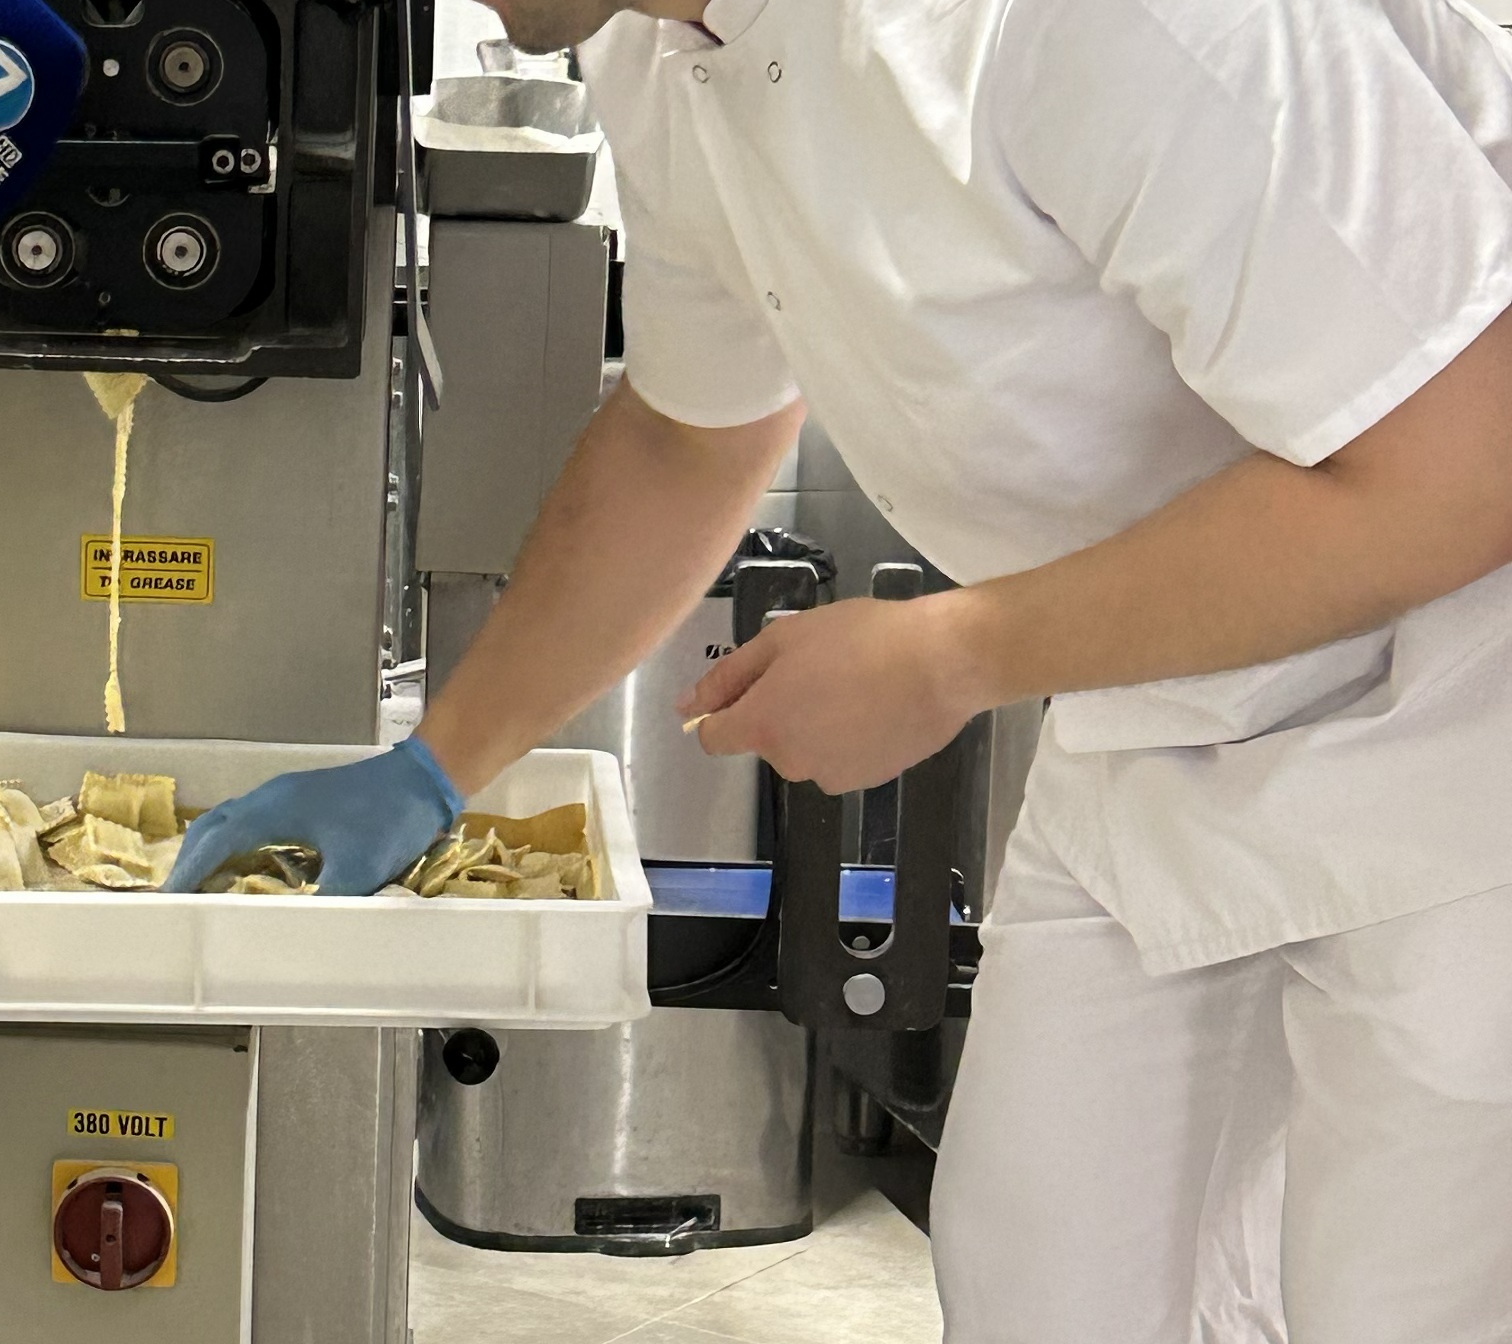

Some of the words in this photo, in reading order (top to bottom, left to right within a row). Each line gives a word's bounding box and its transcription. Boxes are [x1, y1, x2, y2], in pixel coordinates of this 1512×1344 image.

[93, 548, 203, 565] INRASSARE
[130, 576, 196, 591] GREASE
[74, 1113, 109, 1134] 380
[118, 1114, 167, 1137] VOLT
